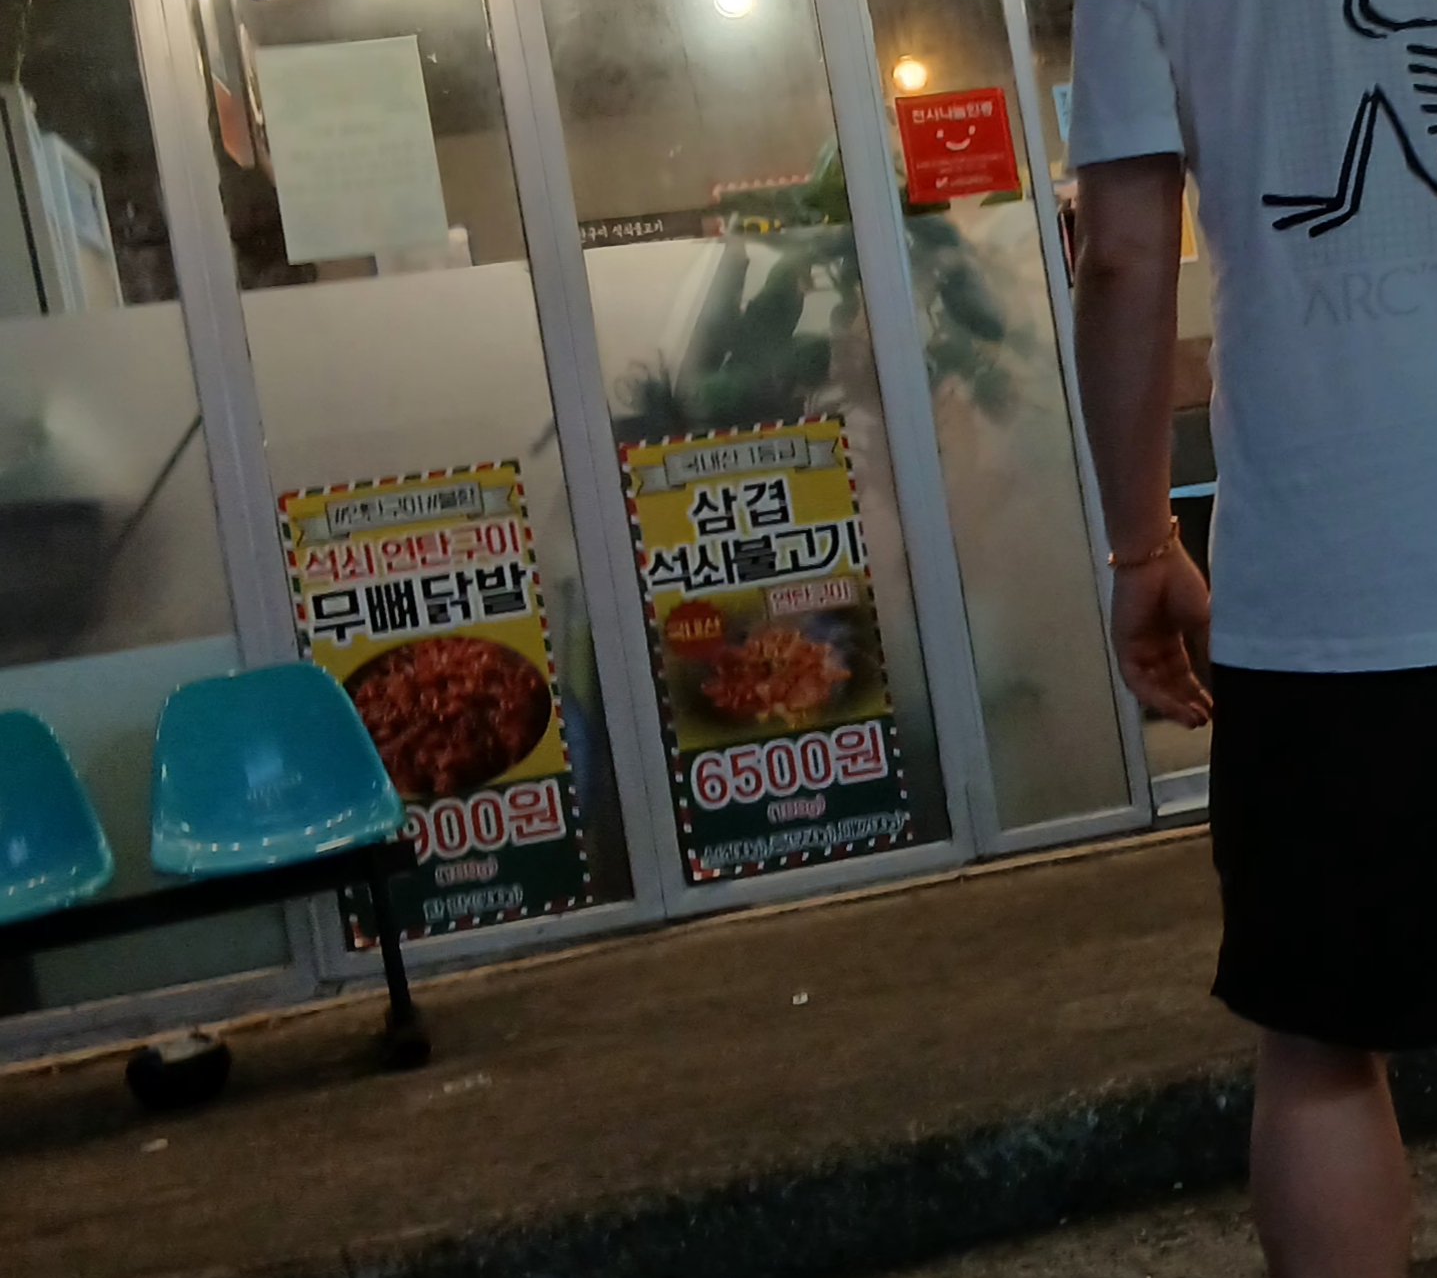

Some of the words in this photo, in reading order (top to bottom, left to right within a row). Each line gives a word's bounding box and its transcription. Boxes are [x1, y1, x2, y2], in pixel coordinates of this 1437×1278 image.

[692, 479, 790, 535] 삼겹
[649, 520, 860, 592] 석쇠불고기
[312, 561, 530, 641] 무뼈닭발
[694, 723, 886, 807] 6500원
[399, 781, 563, 860] 900원
